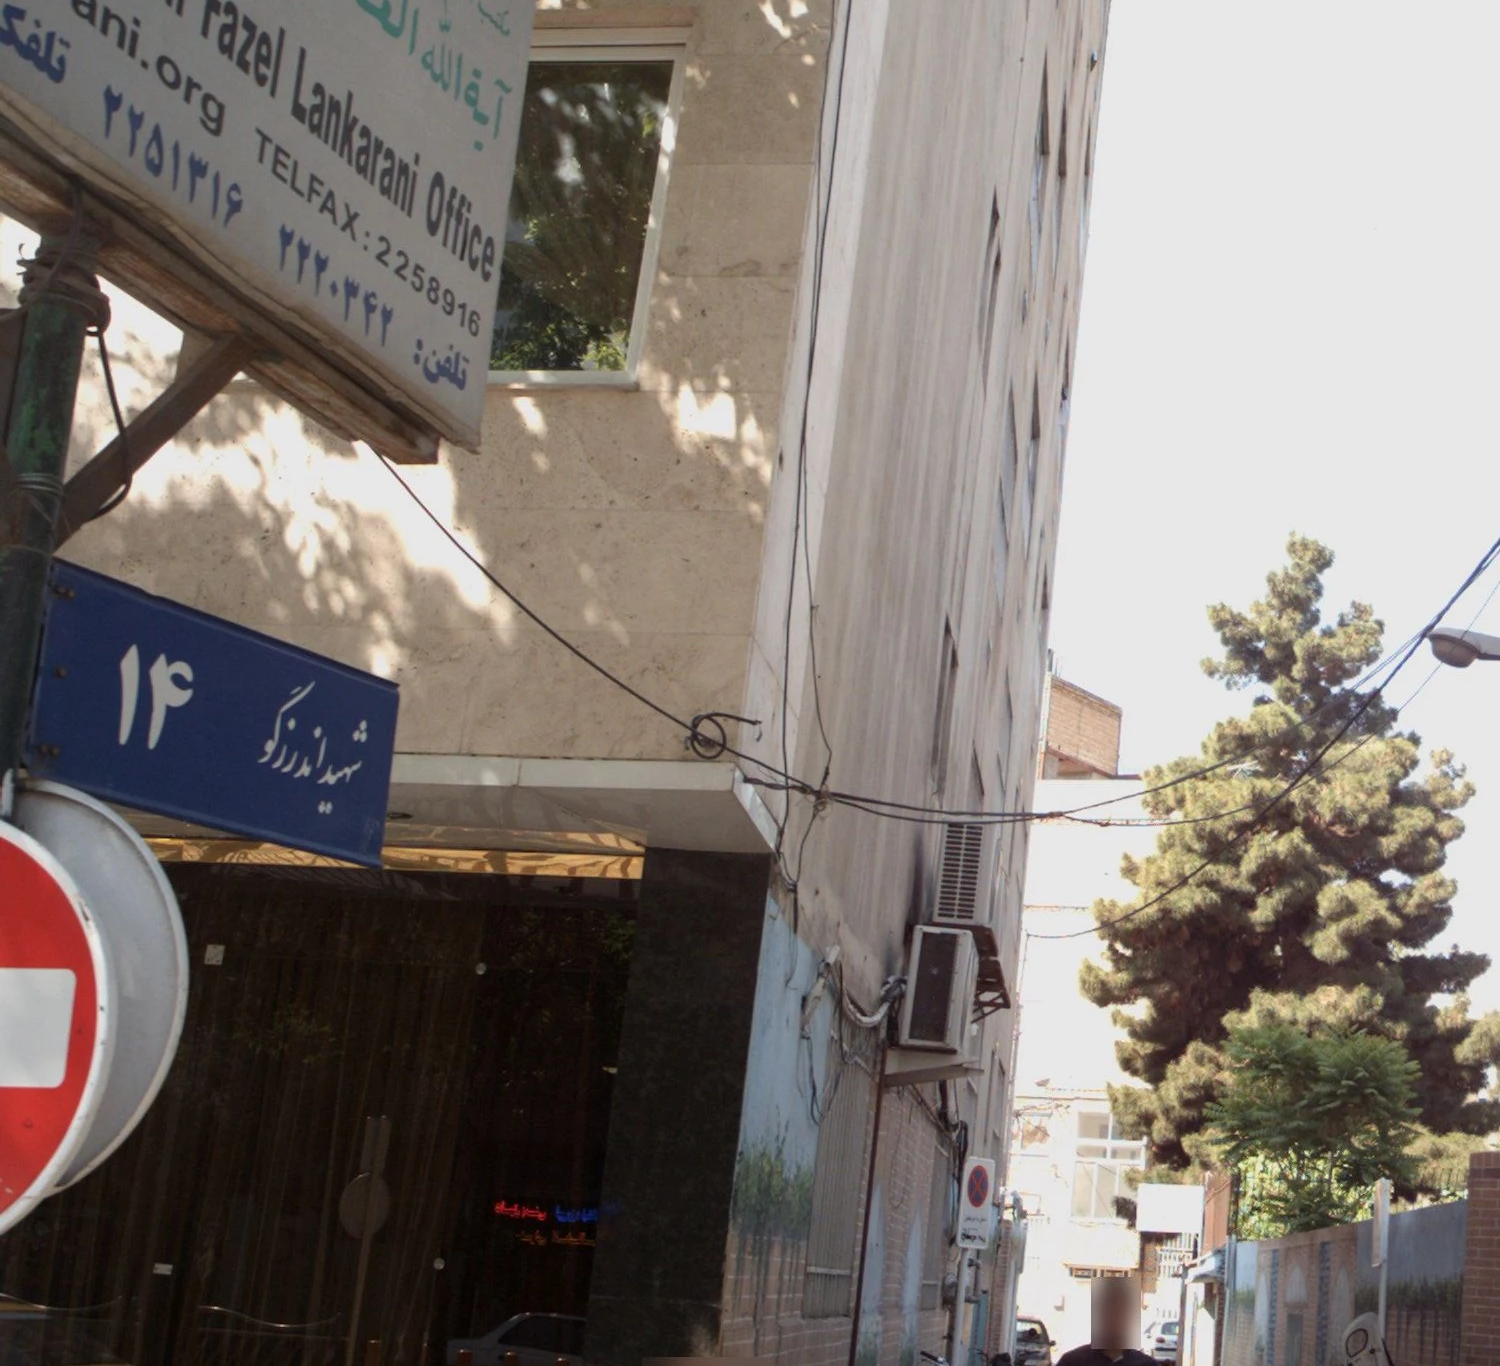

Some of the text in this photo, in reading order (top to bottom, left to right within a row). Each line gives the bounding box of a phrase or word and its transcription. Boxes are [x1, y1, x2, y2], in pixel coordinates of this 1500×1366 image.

[290, 46, 420, 218] Lankarani
[425, 170, 495, 282] Office
[119, 643, 368, 814] شهید اندرزگو ۱۴
